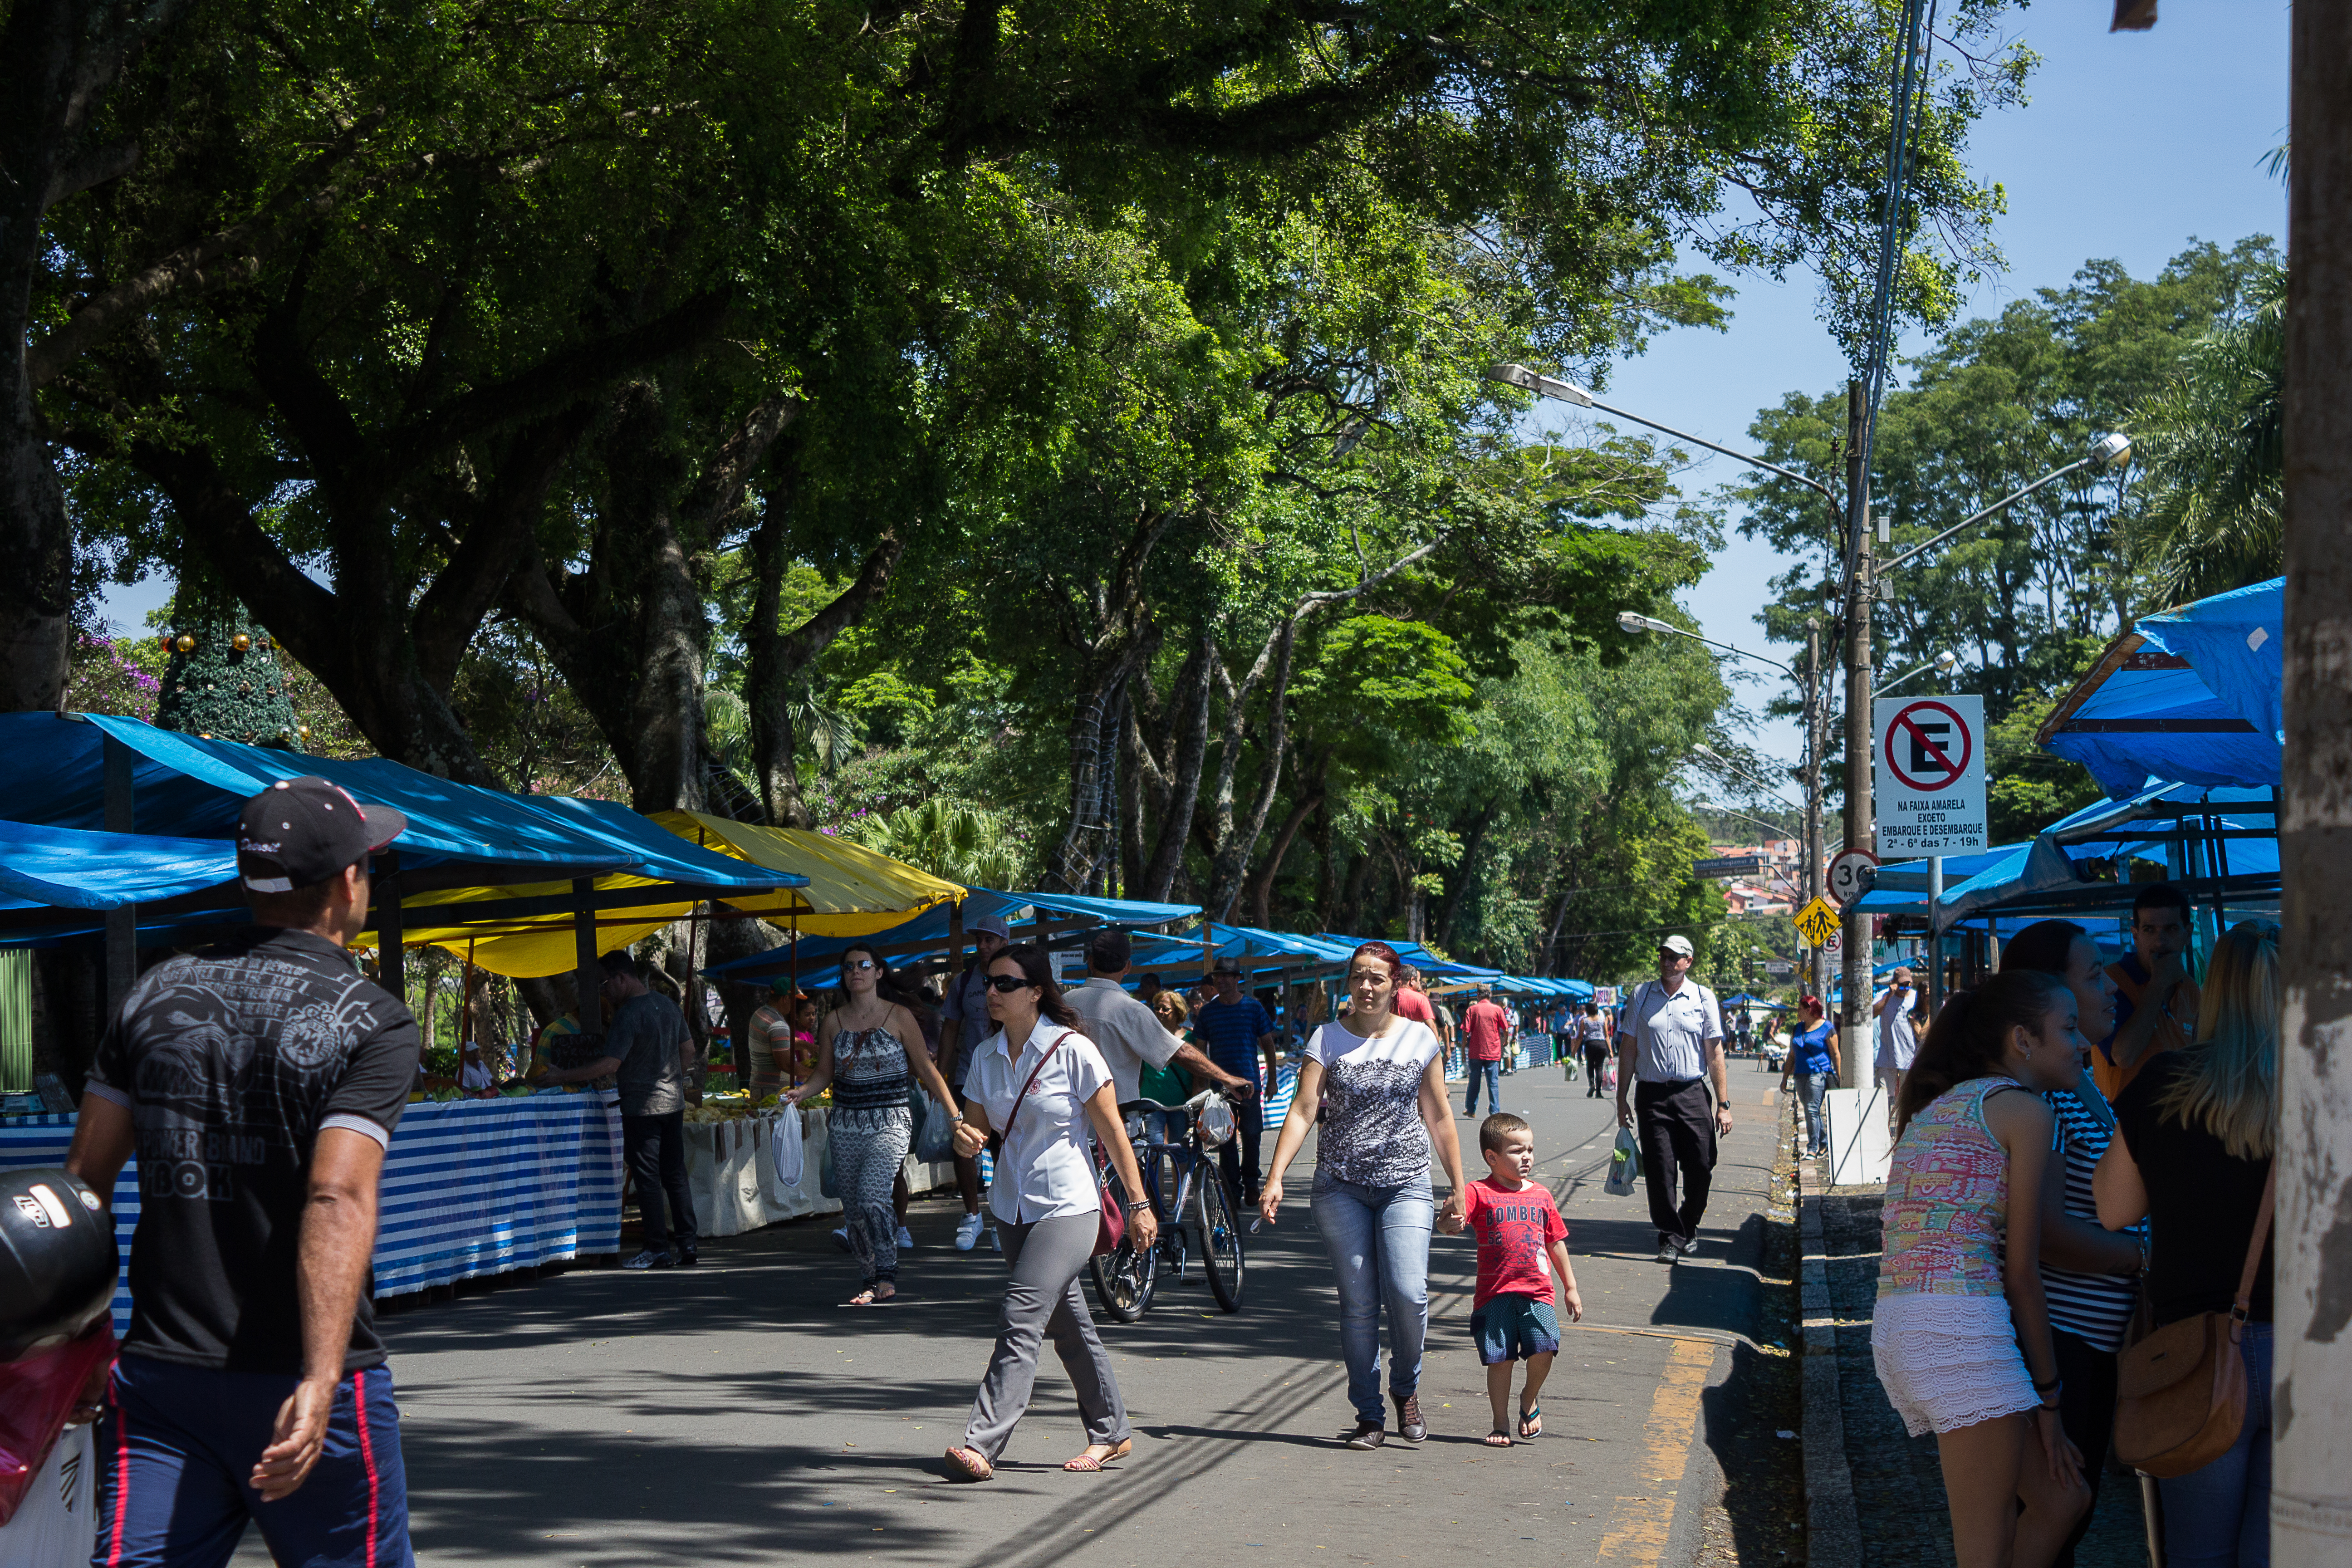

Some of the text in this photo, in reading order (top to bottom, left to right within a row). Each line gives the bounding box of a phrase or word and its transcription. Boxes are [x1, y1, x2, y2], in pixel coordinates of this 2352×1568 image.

[1910, 723, 1950, 772] E
[1898, 799, 1965, 811] NA FAIXA AMARELA
[1918, 813, 1945, 823] EXCETO
[1882, 823, 1982, 836] EMBARQUE E DESEMBARQUE
[1921, 838, 1939, 848] das
[1942, 838, 1949, 847] 7
[1960, 837, 1978, 846] 19h
[1486, 1196, 1522, 1205] VARSITY
[1488, 1230, 1502, 1245] 52
